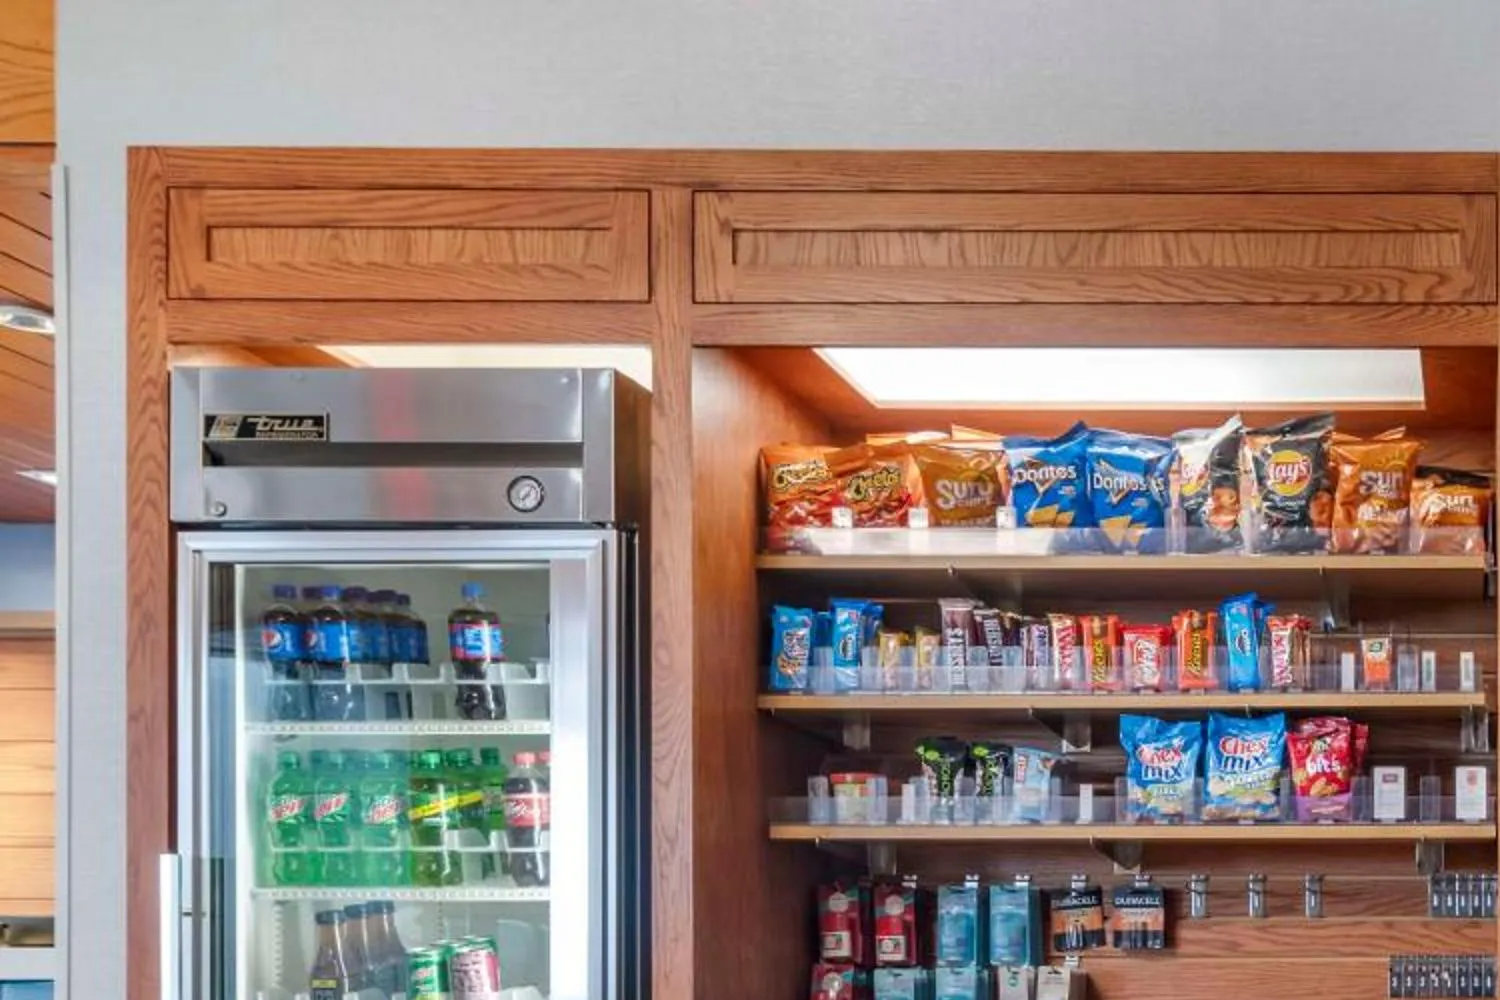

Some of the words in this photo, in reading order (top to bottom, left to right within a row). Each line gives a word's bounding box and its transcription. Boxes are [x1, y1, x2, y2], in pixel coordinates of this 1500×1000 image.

[1014, 465, 1077, 484] Doritos
[1093, 473, 1147, 491] Doritos
[1219, 735, 1269, 756] Chex
